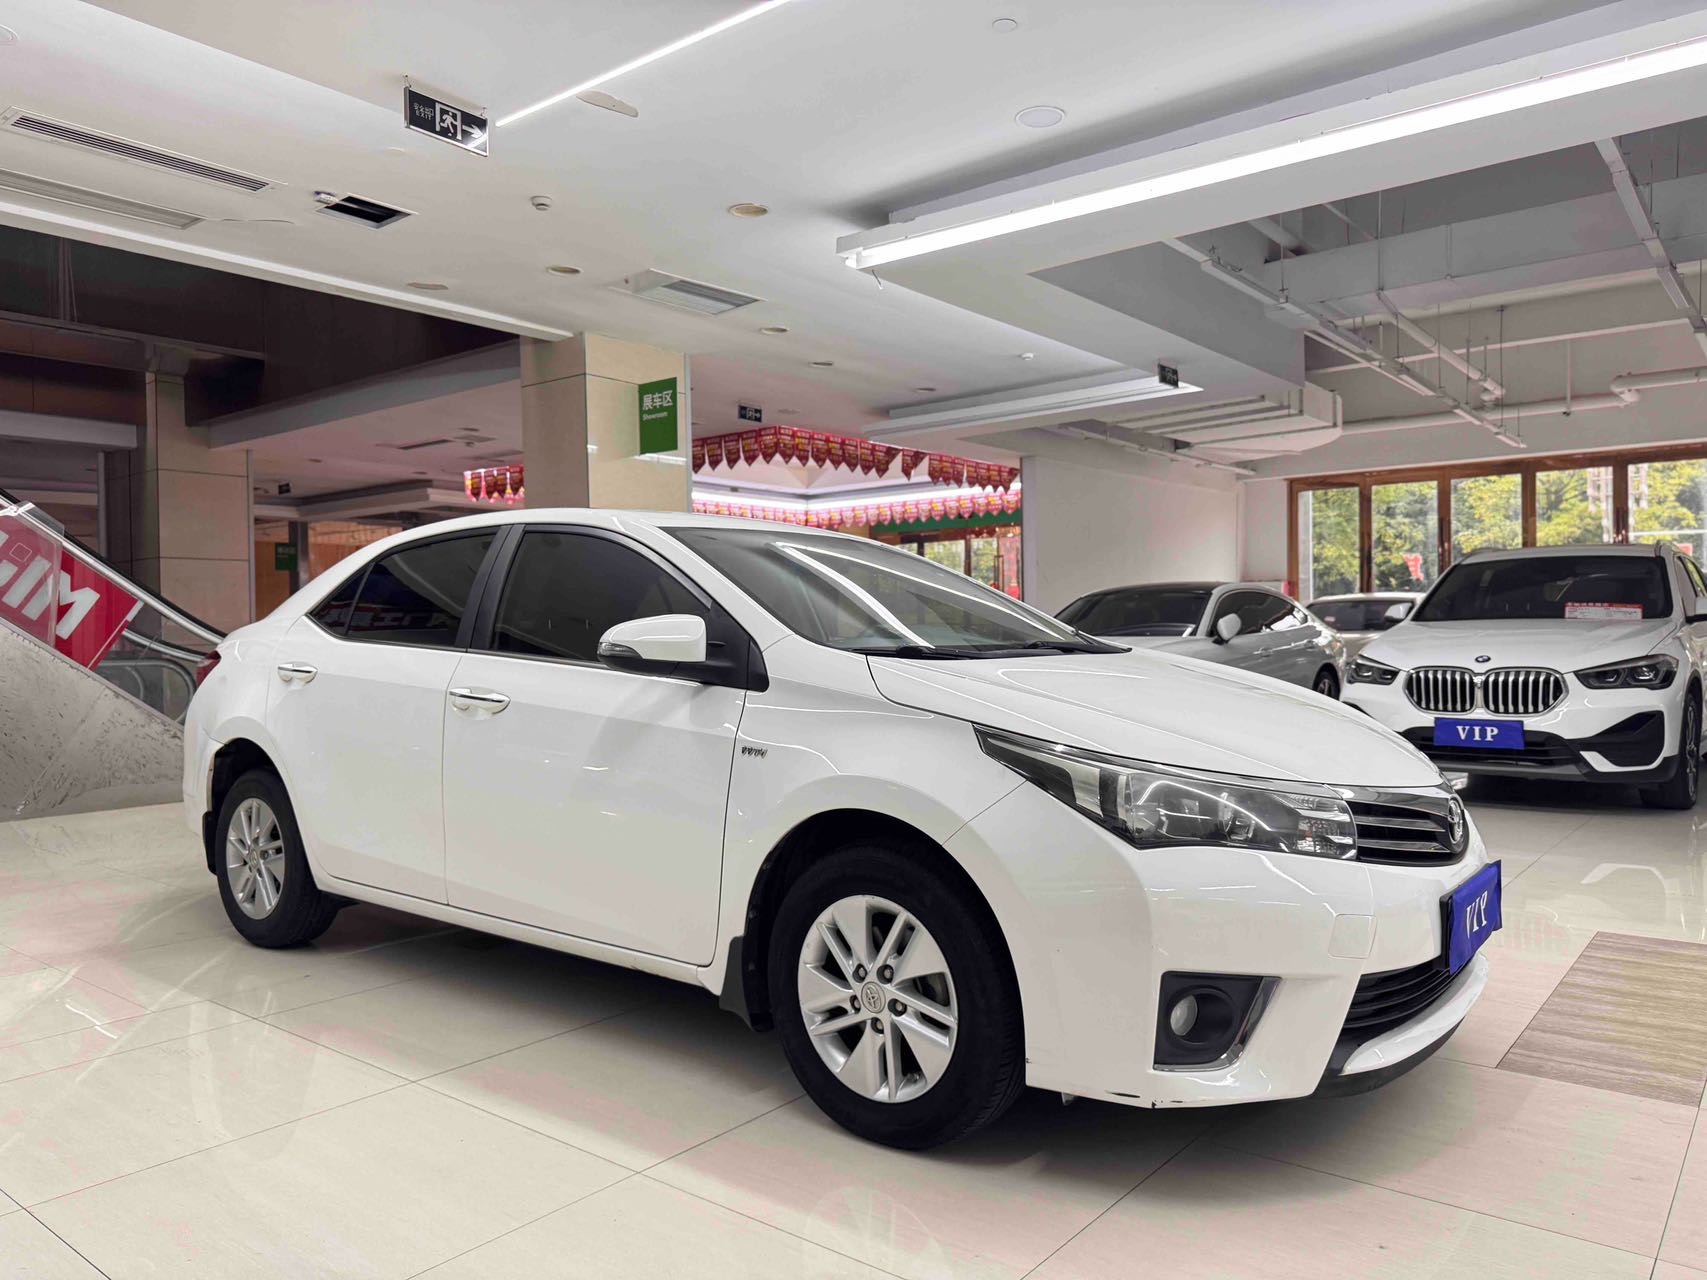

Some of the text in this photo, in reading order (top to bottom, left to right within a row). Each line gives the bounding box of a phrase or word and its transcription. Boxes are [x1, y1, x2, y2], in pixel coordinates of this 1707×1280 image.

[642, 389, 673, 411] 展车区
[1456, 725, 1499, 741] VIP
[1466, 890, 1488, 939] VIP
